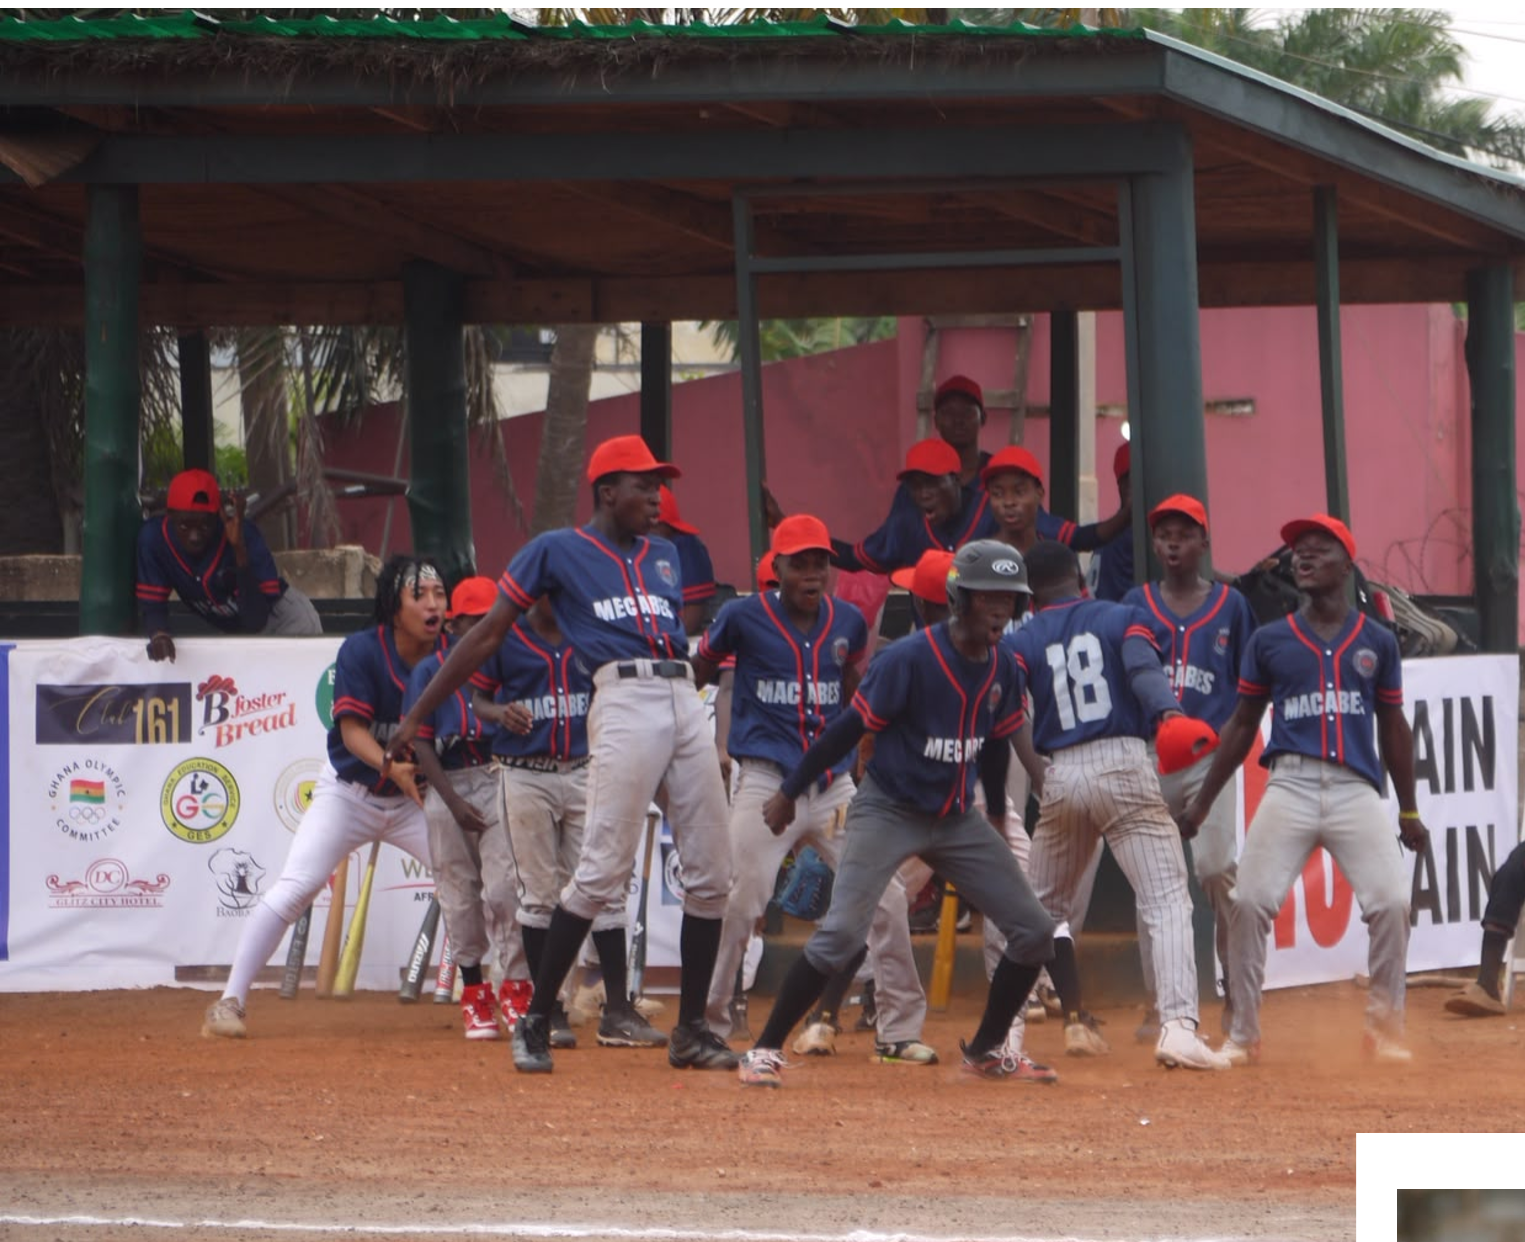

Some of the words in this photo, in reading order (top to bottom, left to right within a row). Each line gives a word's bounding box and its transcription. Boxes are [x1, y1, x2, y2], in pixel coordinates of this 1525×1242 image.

[1045, 631, 1113, 731] 18
[133, 697, 180, 744] 161
[214, 702, 297, 750] Bread
[48, 761, 80, 798] GHANA
[85, 759, 126, 798] OLYMPIC
[56, 818, 120, 842] COMMITTEE
[187, 830, 212, 841] GES
